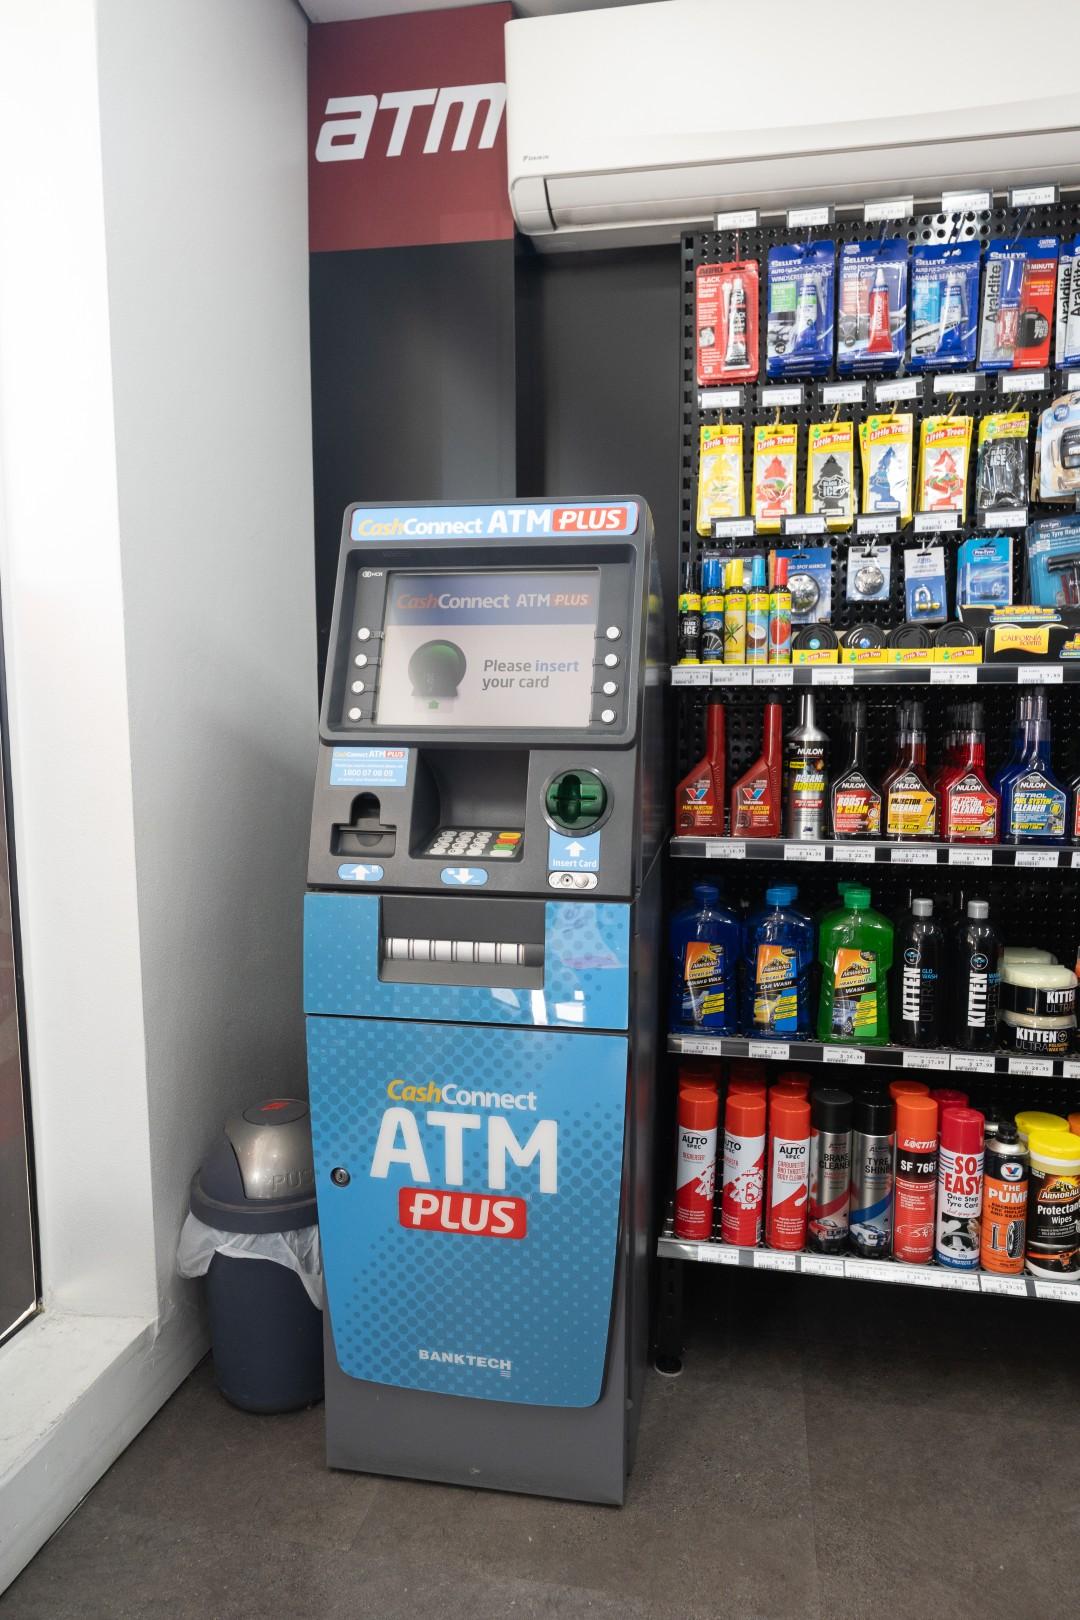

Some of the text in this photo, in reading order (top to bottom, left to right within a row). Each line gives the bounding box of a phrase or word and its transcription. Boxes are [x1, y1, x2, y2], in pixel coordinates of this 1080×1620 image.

[926, 431, 945, 444] Little
[487, 508, 551, 534] ATM
[558, 509, 622, 531] PLUS
[516, 593, 551, 608] ATM
[553, 593, 589, 606] PLUS
[484, 659, 579, 673] Please insert
[482, 675, 550, 690] your card
[552, 859, 597, 869] Insert Card
[902, 966, 921, 1022] KITTEN
[967, 972, 988, 1028] KITTEN
[1016, 1026, 1057, 1043] KITTEN
[681, 1134, 708, 1145] AUTO
[370, 1107, 558, 1194] ATM
[779, 1146, 806, 1155] AUTO
[866, 1157, 889, 1166] TYRE
[900, 1159, 914, 1172] SF
[954, 1155, 978, 1176] SO
[944, 1172, 981, 1196] EASY
[1002, 1184, 1021, 1192] THE
[946, 1193, 962, 1202] One
[947, 1199, 962, 1208] Tyre
[409, 1192, 516, 1235] PLUS
[1037, 1200, 1080, 1215] Protectan
[1051, 1215, 1072, 1225] Wipes
[418, 1349, 512, 1371] BANKTECH
